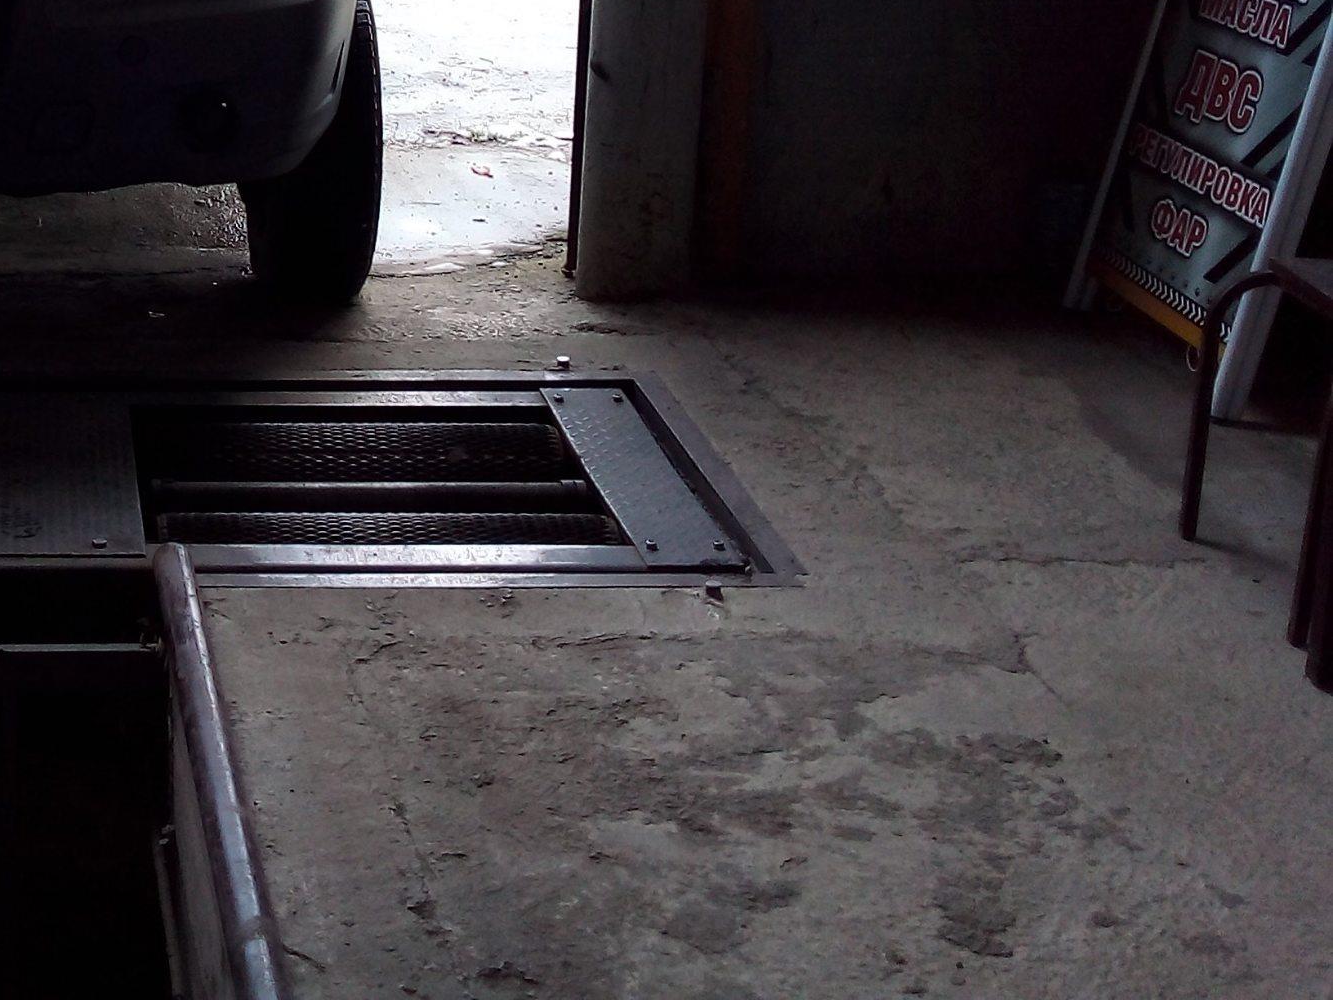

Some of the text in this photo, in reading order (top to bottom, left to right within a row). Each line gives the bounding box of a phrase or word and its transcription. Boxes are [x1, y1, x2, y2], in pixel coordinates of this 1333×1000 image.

[1175, 49, 1263, 133] ДВС
[1125, 120, 1271, 229] РЕГУЛИРОВКА
[1151, 199, 1208, 258] ФАР
